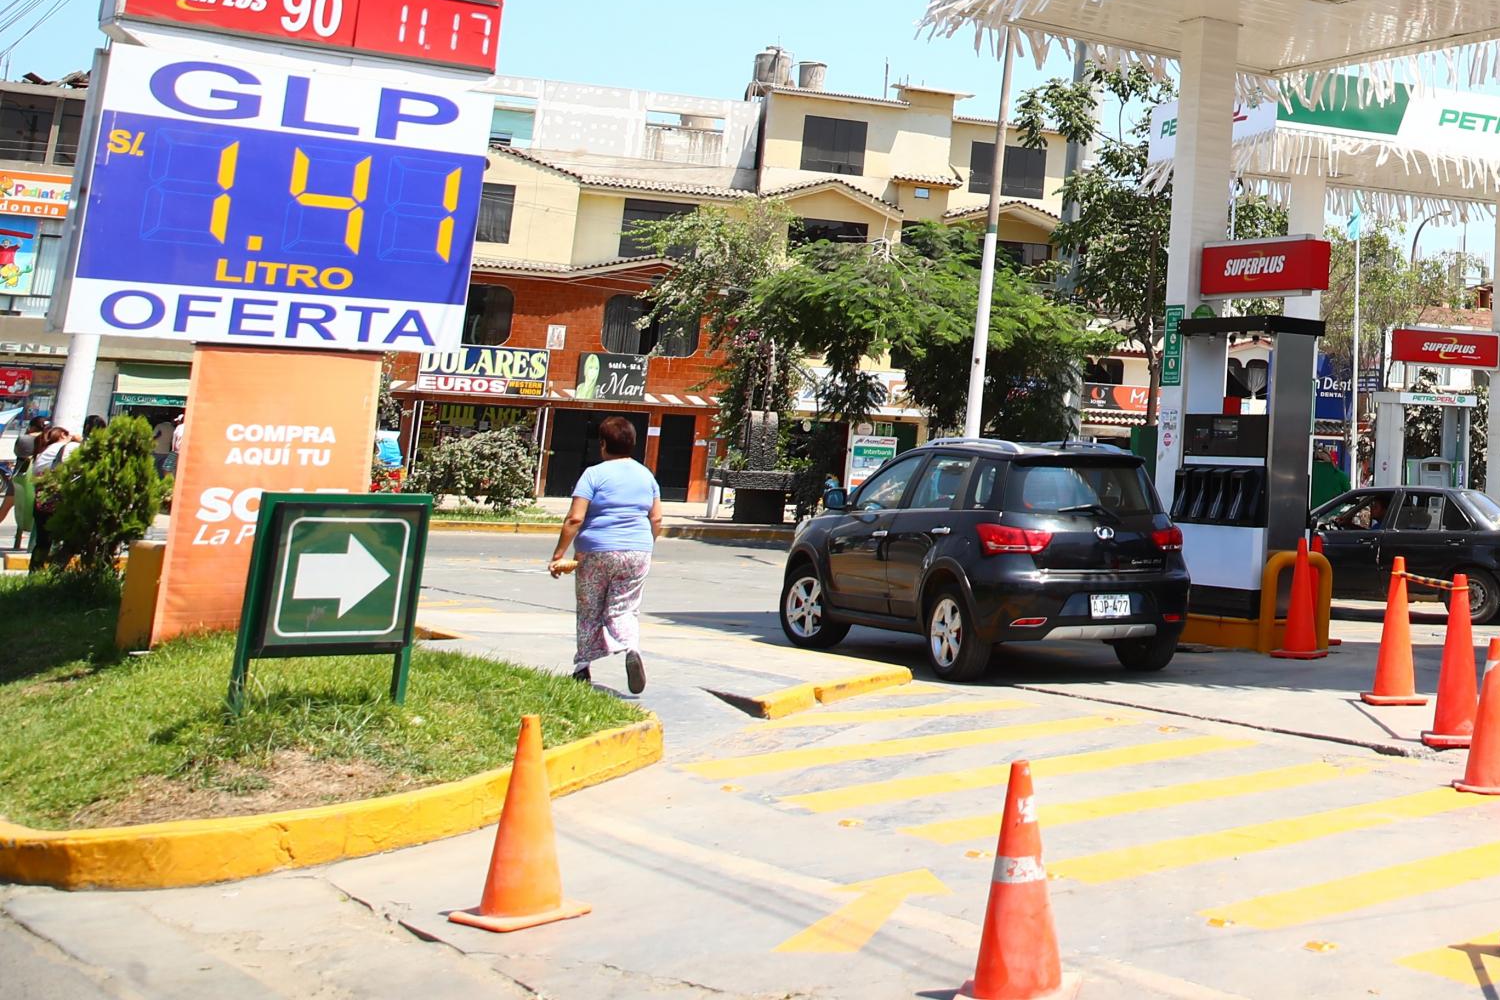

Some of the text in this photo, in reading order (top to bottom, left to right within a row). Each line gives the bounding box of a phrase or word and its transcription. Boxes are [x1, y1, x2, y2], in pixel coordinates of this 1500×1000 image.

[149, 60, 460, 141] GLP
[107, 129, 462, 264] S/. 1.41
[215, 258, 353, 291] LITRO
[1224, 253, 1286, 279] SUPERPLUS
[100, 289, 436, 347] OFERTA
[1422, 342, 1477, 354] SUPERPLUS
[419, 376, 506, 393] EUROS
[1412, 394, 1456, 404] PETROPERU
[225, 424, 336, 444] COMPRA
[225, 446, 331, 467] AQUÍ TU
[192, 524, 227, 545] La
